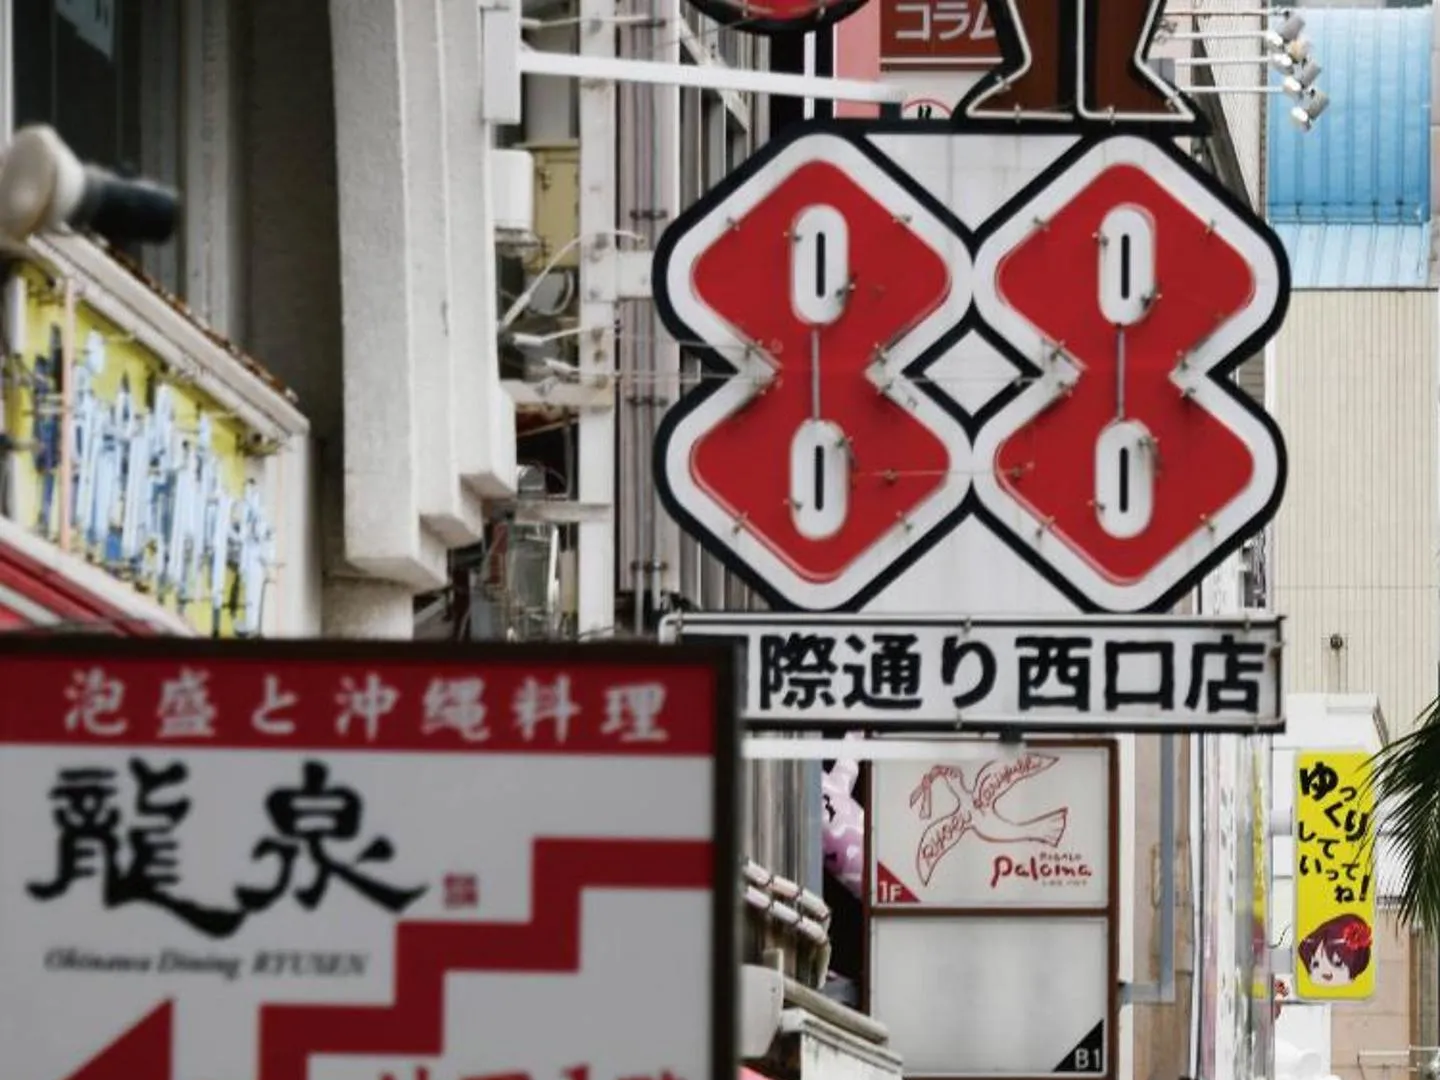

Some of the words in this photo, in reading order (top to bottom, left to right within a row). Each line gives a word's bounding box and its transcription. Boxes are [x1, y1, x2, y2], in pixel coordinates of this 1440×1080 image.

[738, 632, 1266, 713] 際通り西口店
[64, 669, 669, 742] 泡盛と沖縄料理
[25, 757, 429, 939] 龍泉
[990, 855, 1092, 889] Paloma
[879, 880, 903, 902] 1F
[44, 947, 152, 973] Okinawa
[157, 949, 241, 981] Dining
[250, 952, 370, 977] RYUSEN
[1075, 1049, 1102, 1070] B1
